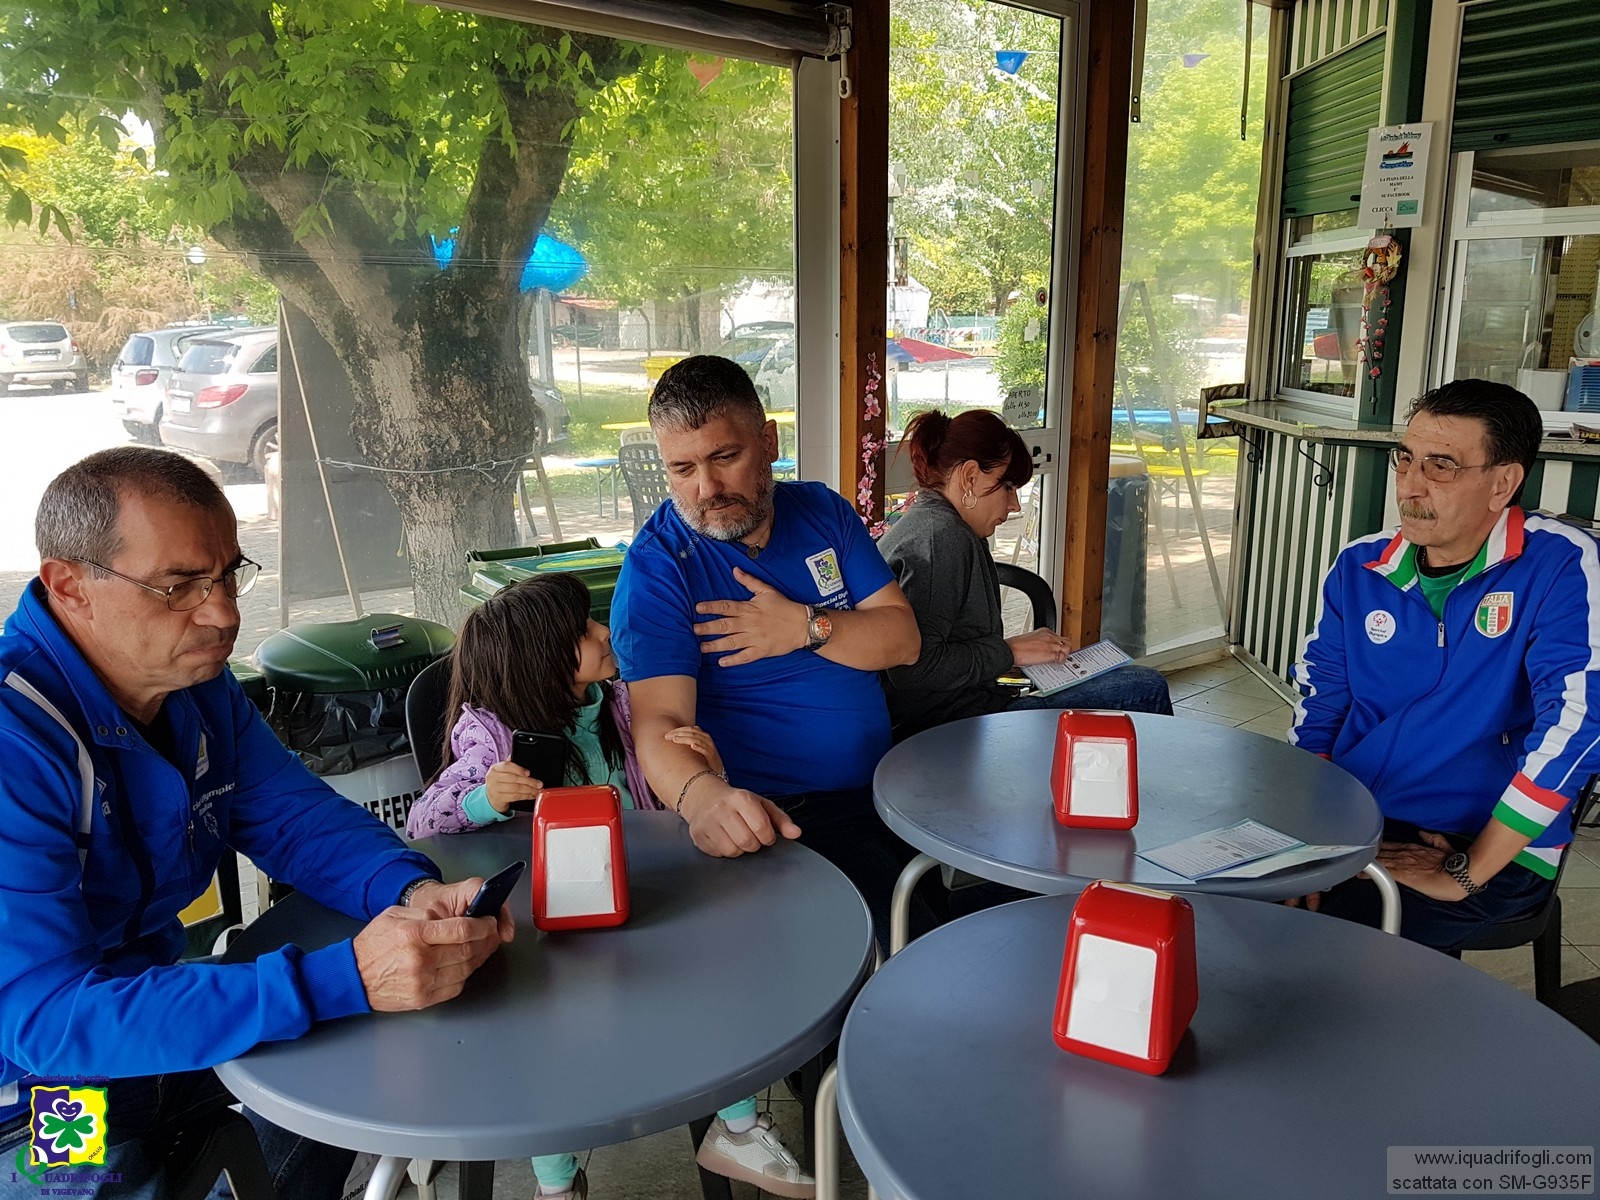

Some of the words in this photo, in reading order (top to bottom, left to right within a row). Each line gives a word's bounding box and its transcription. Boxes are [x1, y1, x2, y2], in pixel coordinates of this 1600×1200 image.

[1008, 390, 1031, 399] APERTO
[1481, 595, 1508, 604] ITALIA
[363, 788, 423, 829] FFER
